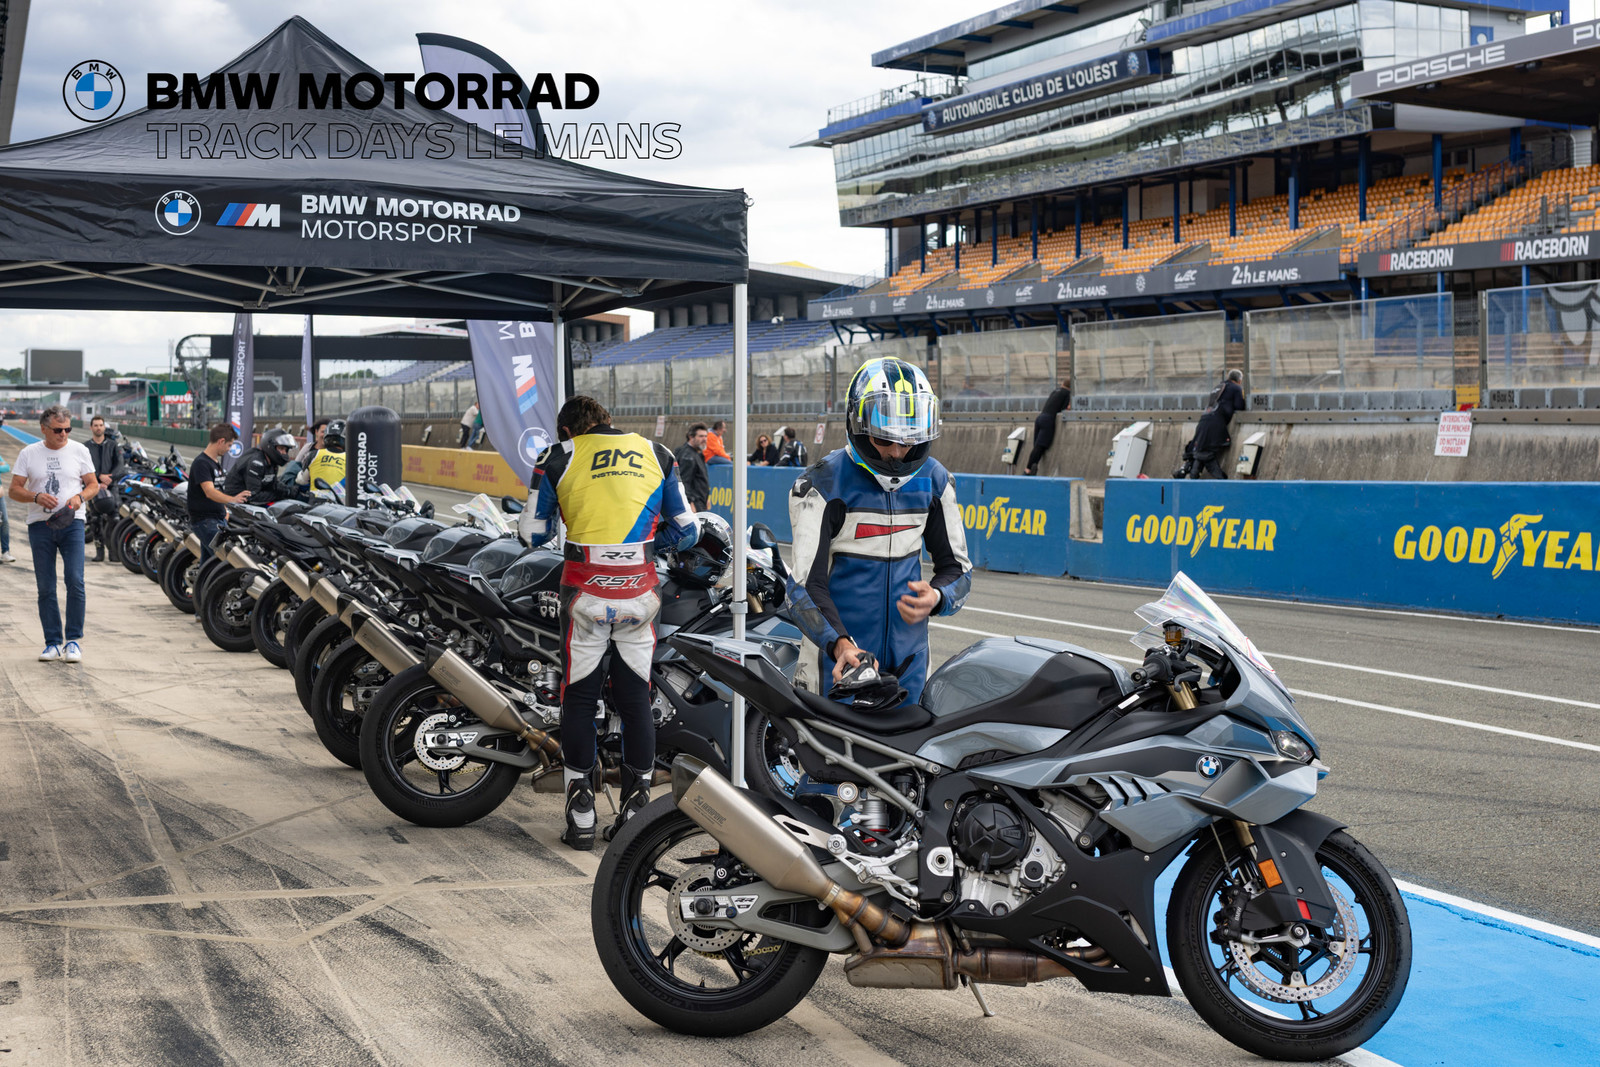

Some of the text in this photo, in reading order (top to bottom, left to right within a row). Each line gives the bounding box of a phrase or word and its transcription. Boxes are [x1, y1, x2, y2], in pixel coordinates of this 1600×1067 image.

[1376, 44, 1505, 88] PORSCHE
[942, 60, 1118, 124] AUTOMOBILE CLUB DE L'OUEST
[301, 194, 521, 223] BMW MOTORRAD
[301, 220, 478, 244] MOTORSPORT
[1390, 248, 1453, 271] RACEBORN
[1514, 235, 1589, 261] RACEBORN
[1252, 271, 1266, 283] LE
[1267, 267, 1298, 282] MANS
[1073, 287, 1082, 298] LE
[1083, 285, 1107, 297] MANS
[236, 339, 246, 407] MOTORSPORT
[356, 432, 368, 501] MOTORRAD
[591, 449, 643, 471] BMC
[1126, 514, 1278, 552] GOODYEAR
[1394, 524, 1600, 572] GOODYEA
[584, 572, 648, 588] RST
[1234, 906, 1242, 922] BMW
